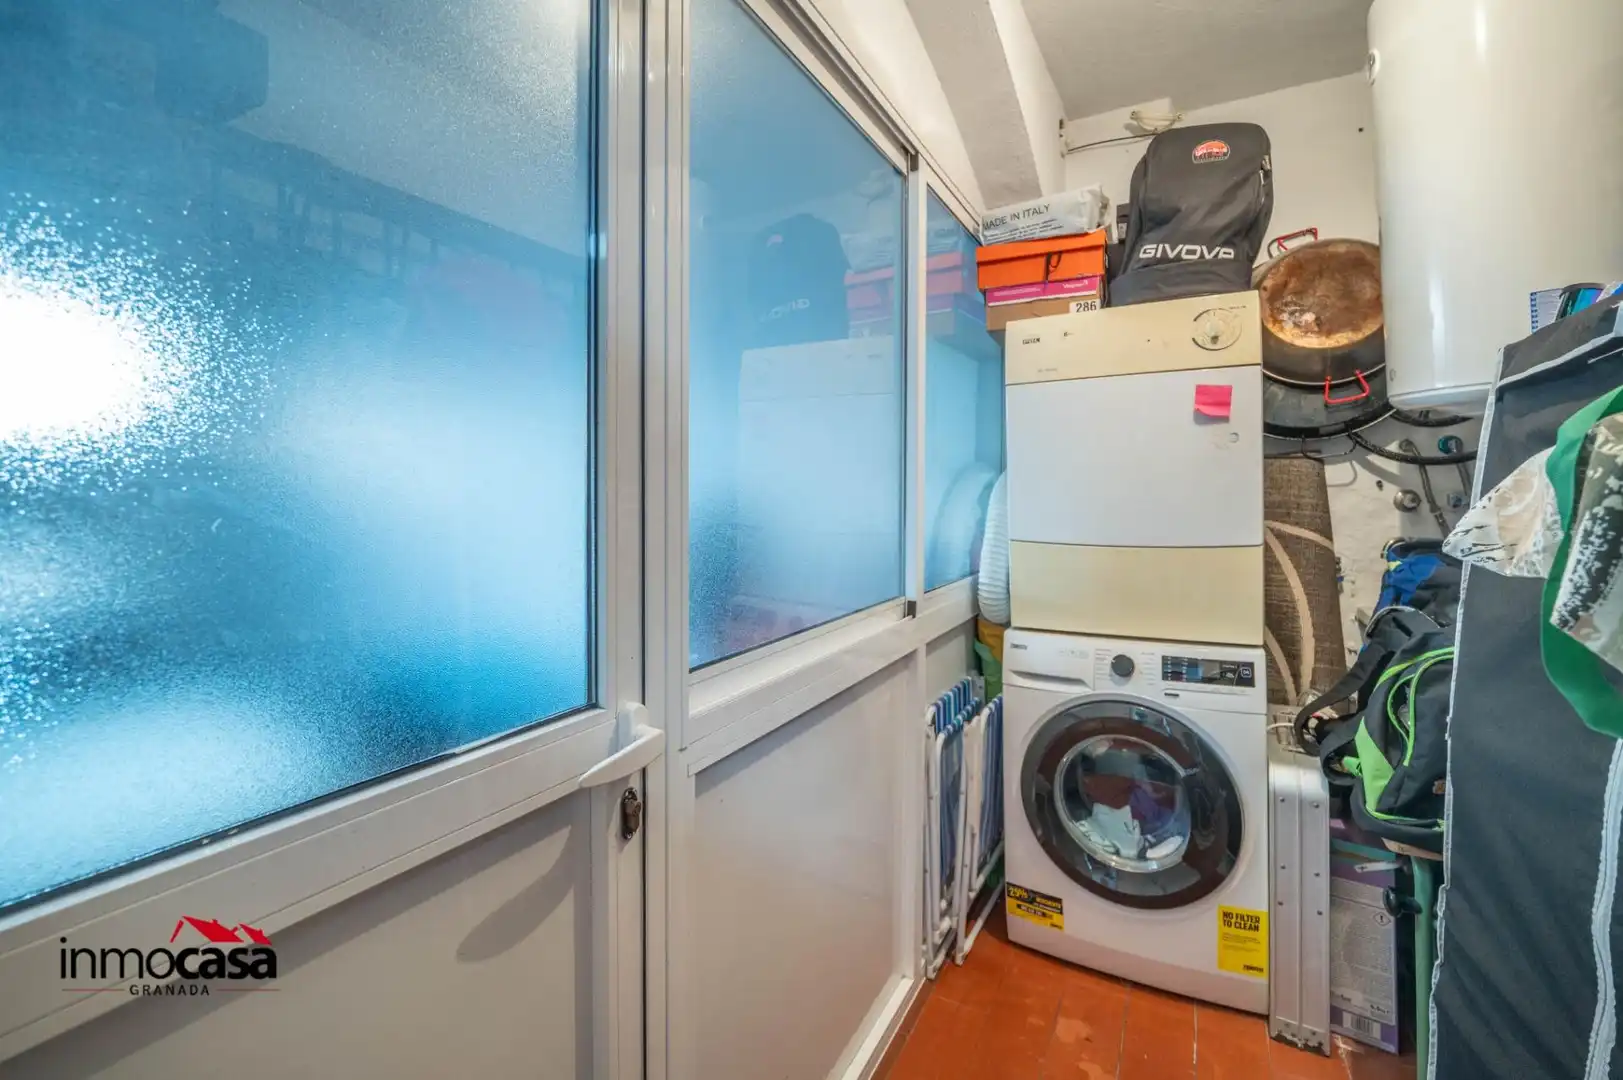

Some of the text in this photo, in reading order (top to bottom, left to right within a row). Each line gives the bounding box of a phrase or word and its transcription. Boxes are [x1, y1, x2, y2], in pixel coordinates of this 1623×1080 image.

[983, 216, 1007, 230] MADE
[1010, 212, 1020, 221] IN
[1022, 204, 1050, 219] ITALY
[1076, 301, 1097, 313] 286
[1223, 911, 1260, 924] NO FILTER
[1223, 920, 1259, 932] TO CLEAN
